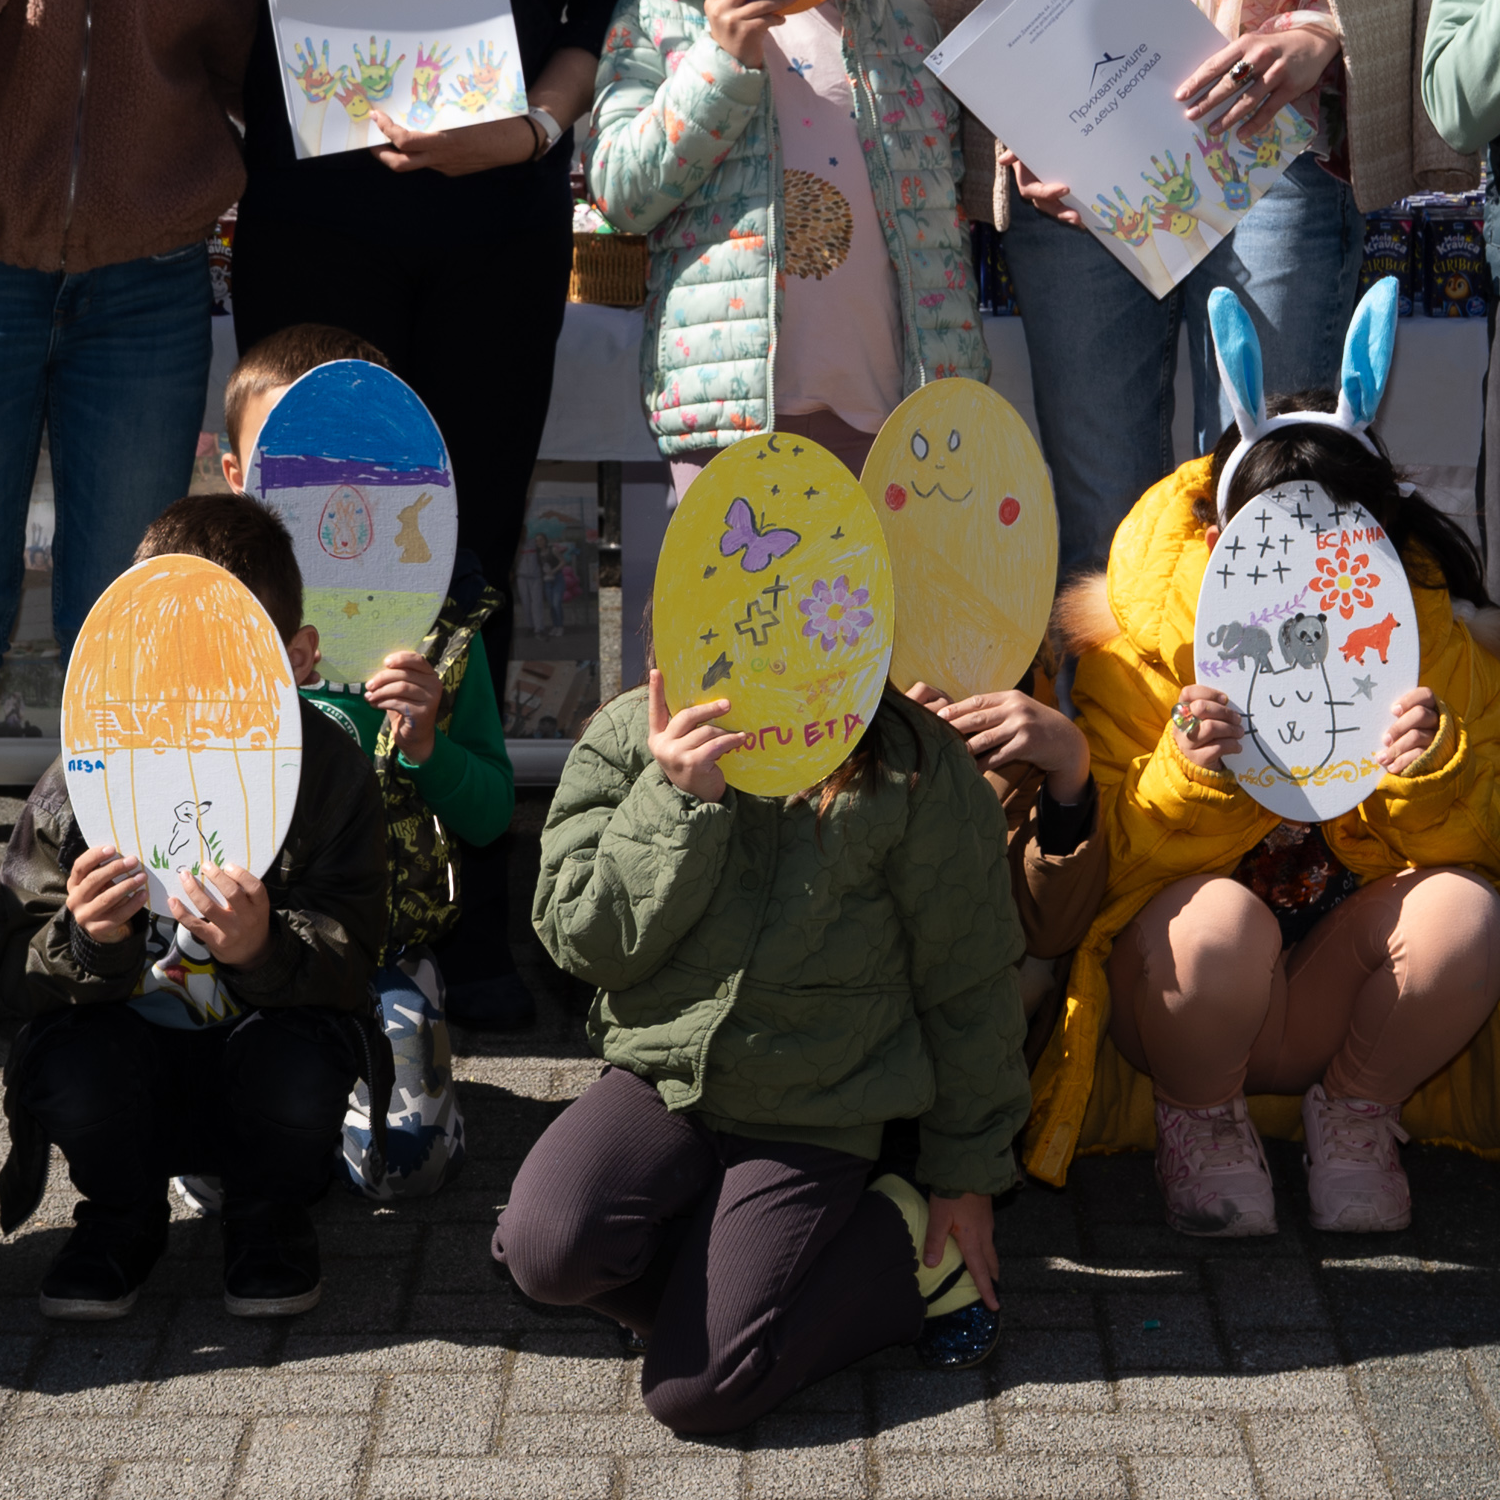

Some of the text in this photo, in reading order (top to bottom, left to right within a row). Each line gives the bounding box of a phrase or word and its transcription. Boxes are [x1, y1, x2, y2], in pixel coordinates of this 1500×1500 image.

[1068, 43, 1148, 124] Прихватилиште
[1080, 52, 1162, 137] за децу Београда
